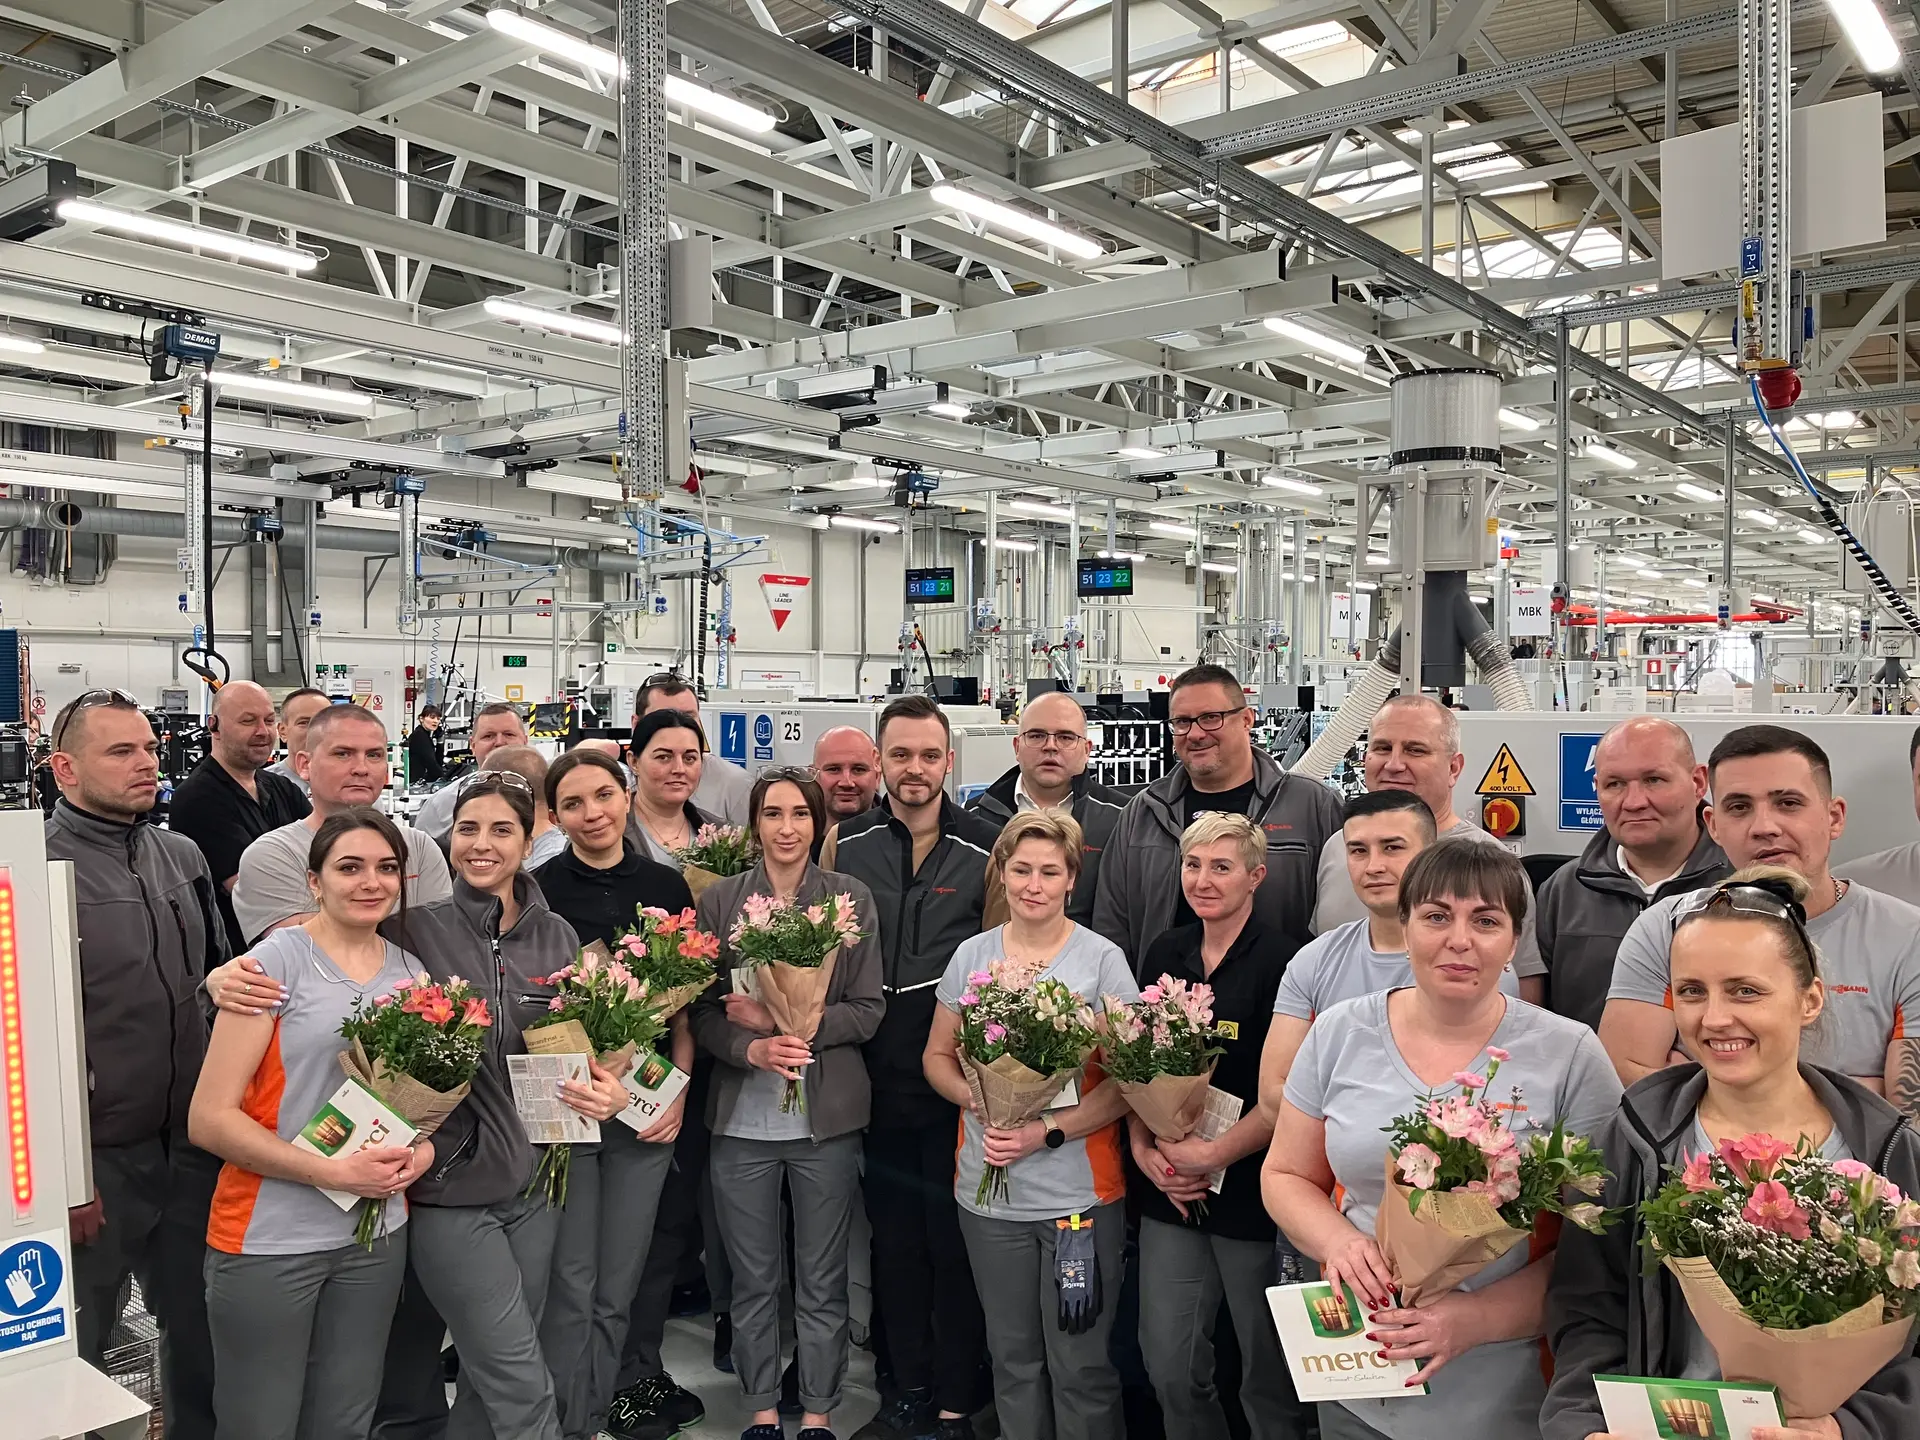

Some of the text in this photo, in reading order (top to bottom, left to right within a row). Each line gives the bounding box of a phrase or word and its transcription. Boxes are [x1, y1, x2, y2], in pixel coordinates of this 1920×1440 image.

[184, 332, 217, 346] DEMAG
[1082, 572, 1128, 584] 51 23 22
[910, 582, 950, 592] 51 23 21
[1340, 610, 1361, 620] MK
[1518, 606, 1542, 616] MBK
[784, 722, 800, 740] 25
[624, 1086, 660, 1116] erci
[0, 1314, 62, 1336] TOSUJ OCHRONĘ
[22, 1330, 38, 1342] RĄK
